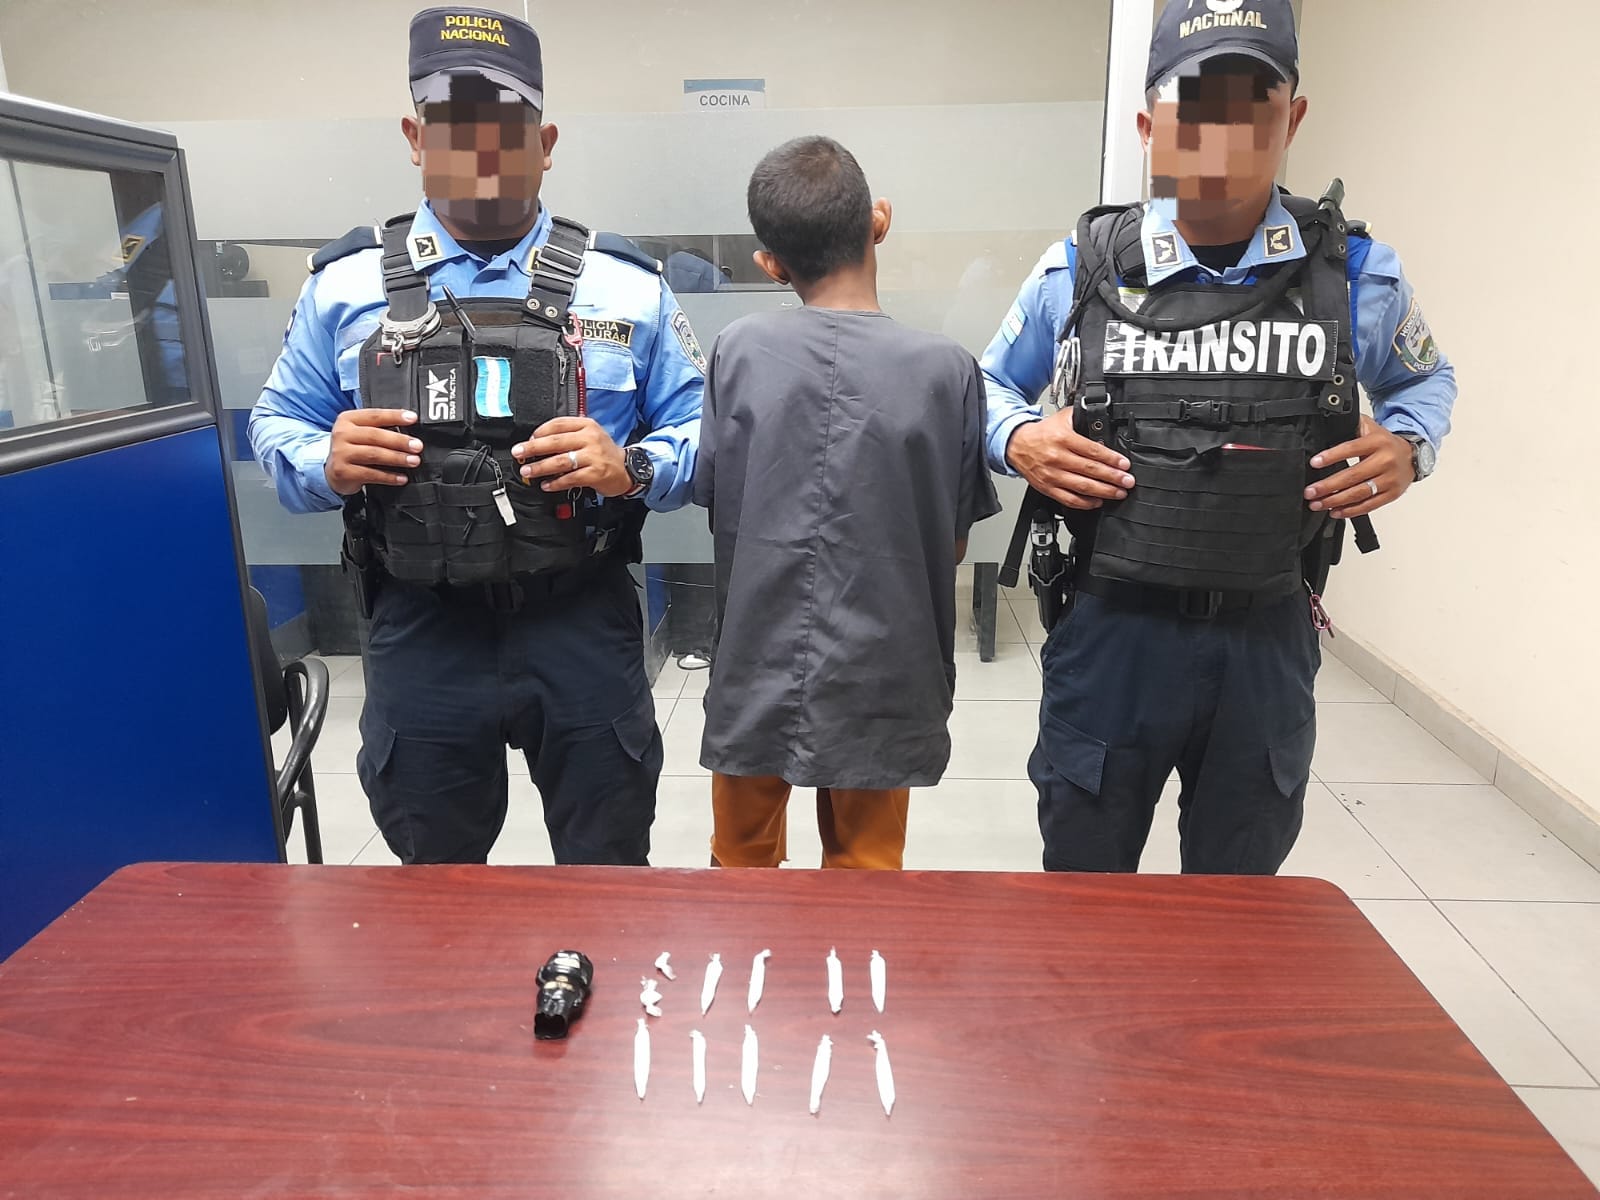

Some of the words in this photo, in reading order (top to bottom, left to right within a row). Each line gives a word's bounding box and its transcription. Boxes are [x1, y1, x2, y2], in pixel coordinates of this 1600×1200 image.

[445, 15, 502, 31] POLICIA
[440, 29, 510, 47] NACIONAL
[699, 95, 750, 106] COCINA
[1117, 320, 1327, 377] TRANSITO
